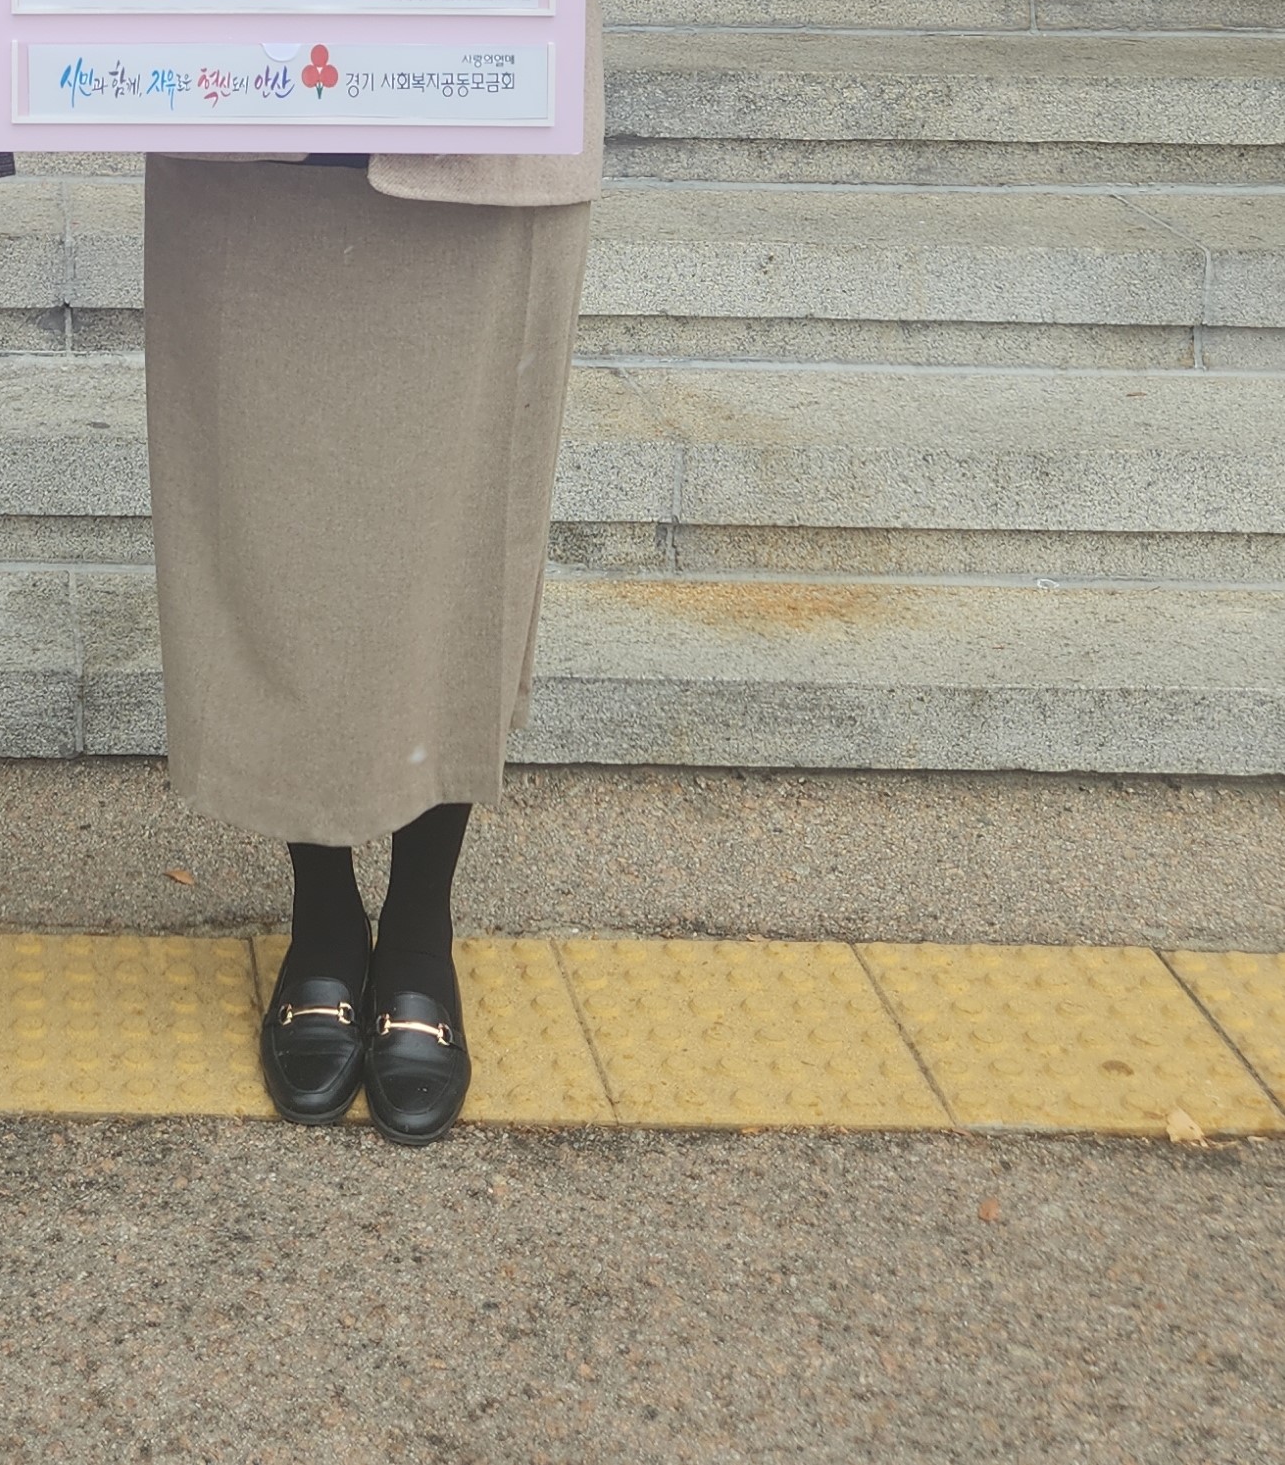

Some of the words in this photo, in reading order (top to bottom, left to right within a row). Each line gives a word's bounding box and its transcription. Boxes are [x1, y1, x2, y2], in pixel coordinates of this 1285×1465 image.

[461, 54, 515, 69] 사랑의열매
[60, 57, 108, 109] 시민과
[146, 68, 193, 110] 자유로운
[197, 66, 250, 109] 혁신도시
[254, 64, 295, 99] 안산
[345, 72, 375, 98] 경기
[380, 71, 515, 98] 사회복지공동모금회
